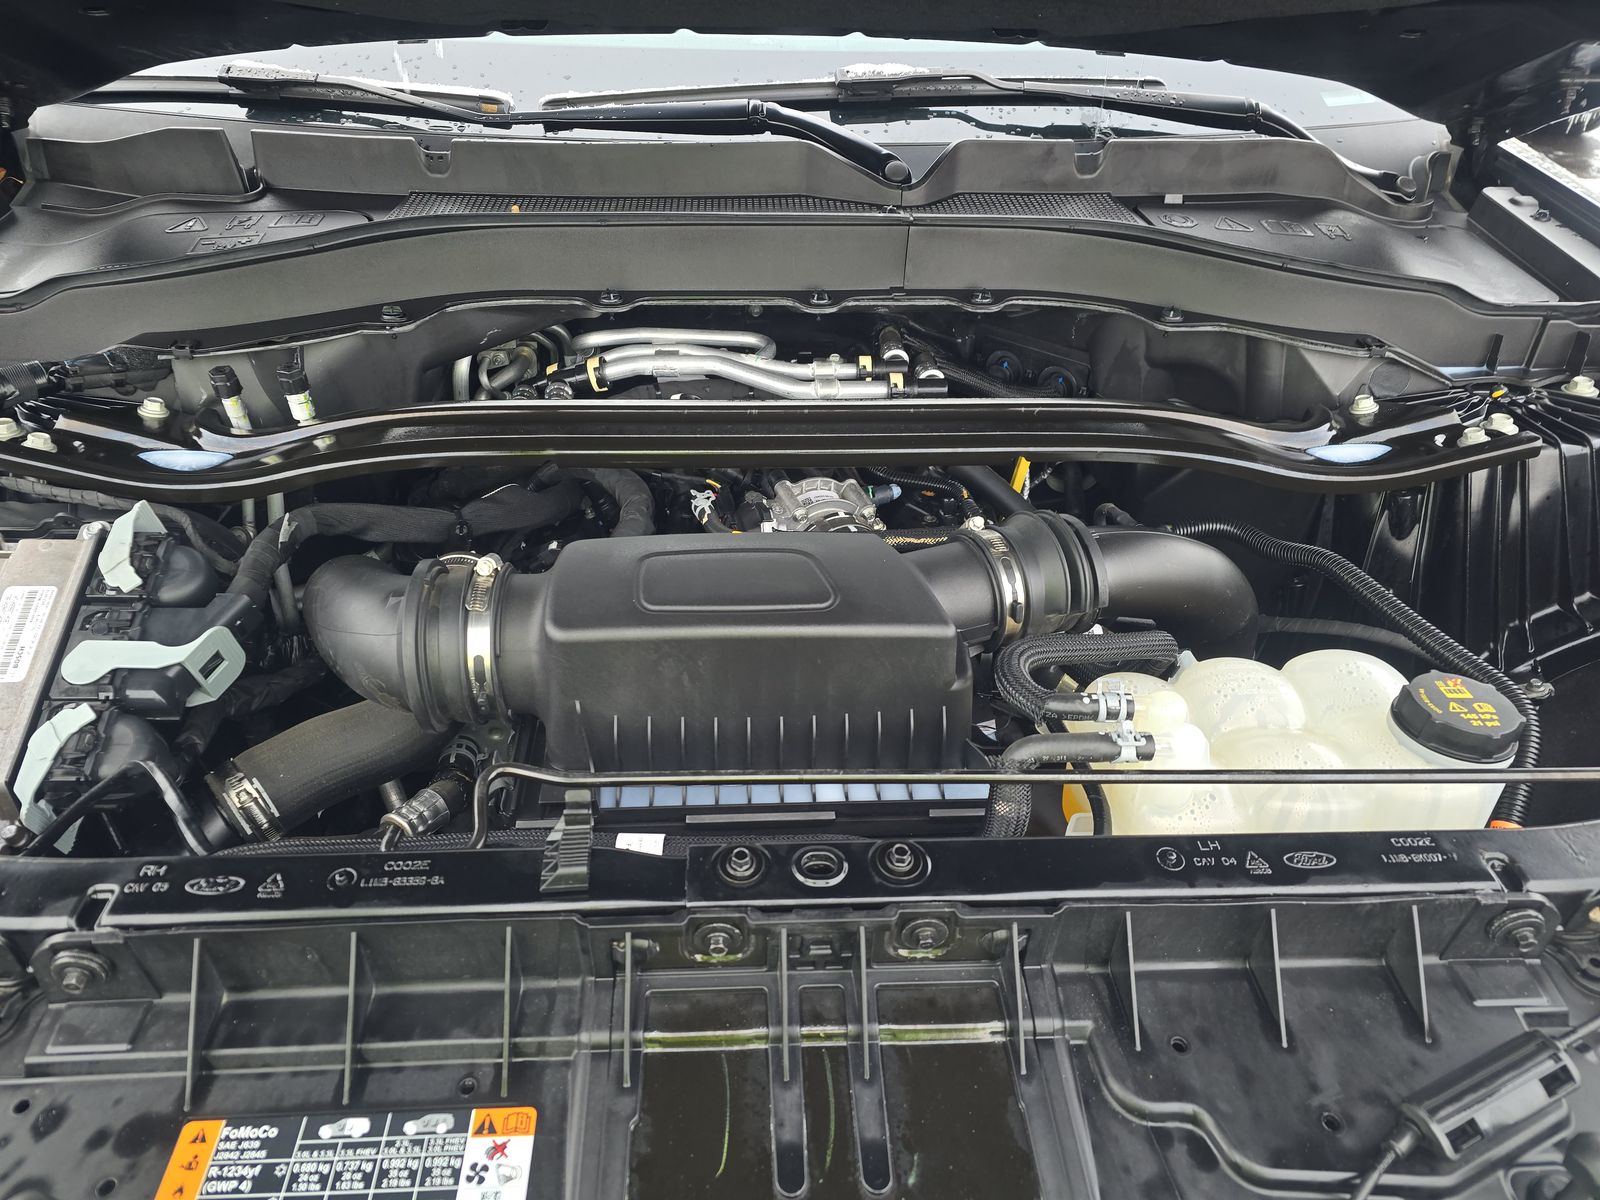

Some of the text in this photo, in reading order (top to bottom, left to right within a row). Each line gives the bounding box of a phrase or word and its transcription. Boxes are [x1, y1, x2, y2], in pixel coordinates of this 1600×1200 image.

[1197, 841, 1221, 851] LH
[139, 864, 168, 877] RH
[220, 1125, 279, 1139] FoMoCo
[218, 1141, 238, 1150] SAE
[207, 1165, 262, 1178] R-1234yf
[202, 1180, 253, 1195] (GWP 4)
